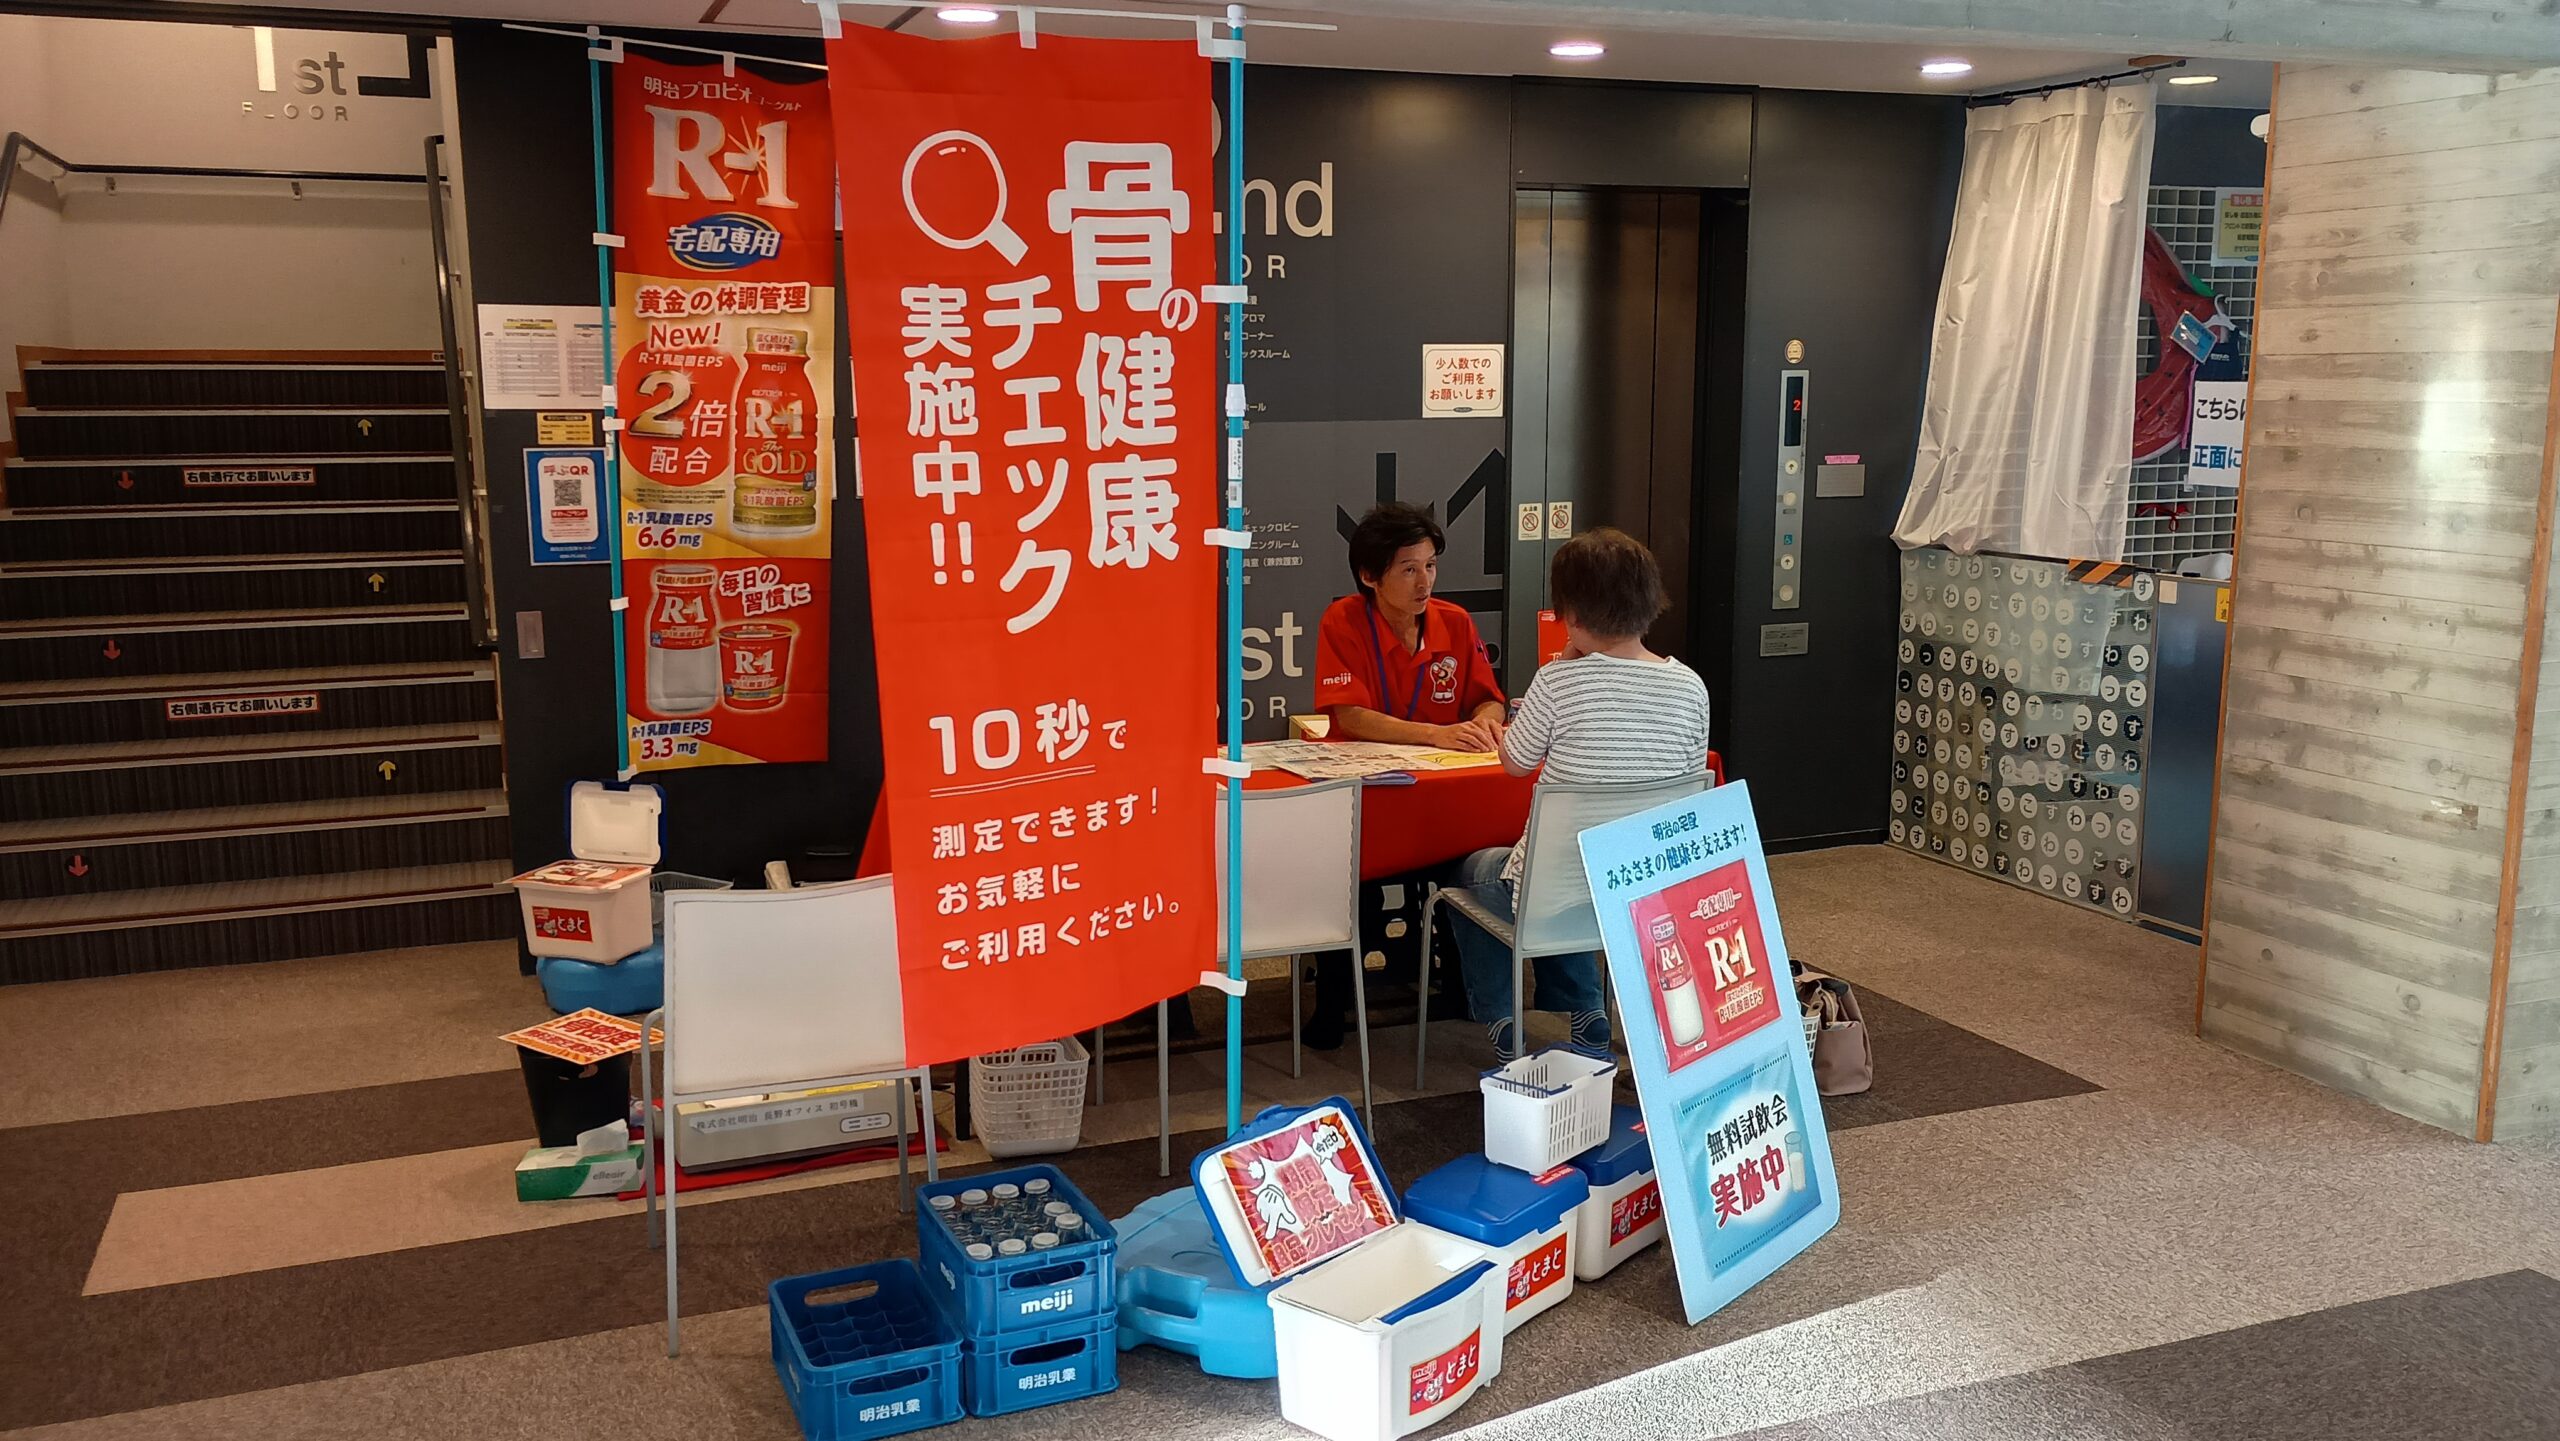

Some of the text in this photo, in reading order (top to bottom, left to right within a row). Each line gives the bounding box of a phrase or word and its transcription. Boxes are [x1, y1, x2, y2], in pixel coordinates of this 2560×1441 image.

[644, 104, 799, 209] R-1
[669, 224, 781, 257] 宅配専用
[638, 285, 808, 315] 黄金の体調管理
[650, 322, 721, 349] New!
[638, 351, 724, 368] R-1乳酸菌EPS
[761, 362, 787, 374] meiji
[1435, 357, 1492, 370] 少人数での
[1441, 373, 1486, 385] ご利用を
[1429, 388, 1497, 401] お願いします
[1792, 400, 1801, 411] 2
[744, 397, 806, 439] R-1
[650, 446, 712, 475] 配合
[743, 448, 806, 475] GOLD
[983, 275, 1072, 634] チェック
[187, 471, 312, 483] 右側通行でお願いします
[627, 511, 713, 526] R-1乳酸菌EPS
[721, 568, 777, 594] 毎日の
[659, 596, 708, 624] R-1
[744, 586, 809, 614] 習慣に
[1241, 612, 1303, 681] st
[733, 650, 774, 674] R-1
[1323, 673, 1352, 686] meiji
[170, 696, 315, 716] 右側通行でお願いします
[631, 721, 710, 738] R-1乳酸菌EPS
[1652, 811, 1699, 841] 明治の宅配
[936, 862, 1081, 916] お気軽に
[557, 915, 588, 934] とまと
[940, 892, 1180, 971] ご利用ください。
[1659, 943, 1684, 972] R-1
[1704, 926, 1757, 992] R-1
[764, 1104, 824, 1121] 長野オフィス
[1316, 1131, 1339, 1154] 今だけ
[1706, 1093, 1789, 1165] 無料試飲会
[1710, 1144, 1785, 1228] 実施中
[1632, 1189, 1659, 1221] とまと
[1531, 1247, 1562, 1282] とまと
[1020, 1289, 1073, 1316] meiji
[1412, 1360, 1437, 1379] meiji
[1446, 1343, 1477, 1383] とまと
[1018, 1367, 1077, 1391] 明治乳業
[858, 1398, 921, 1424] 明治乳業
